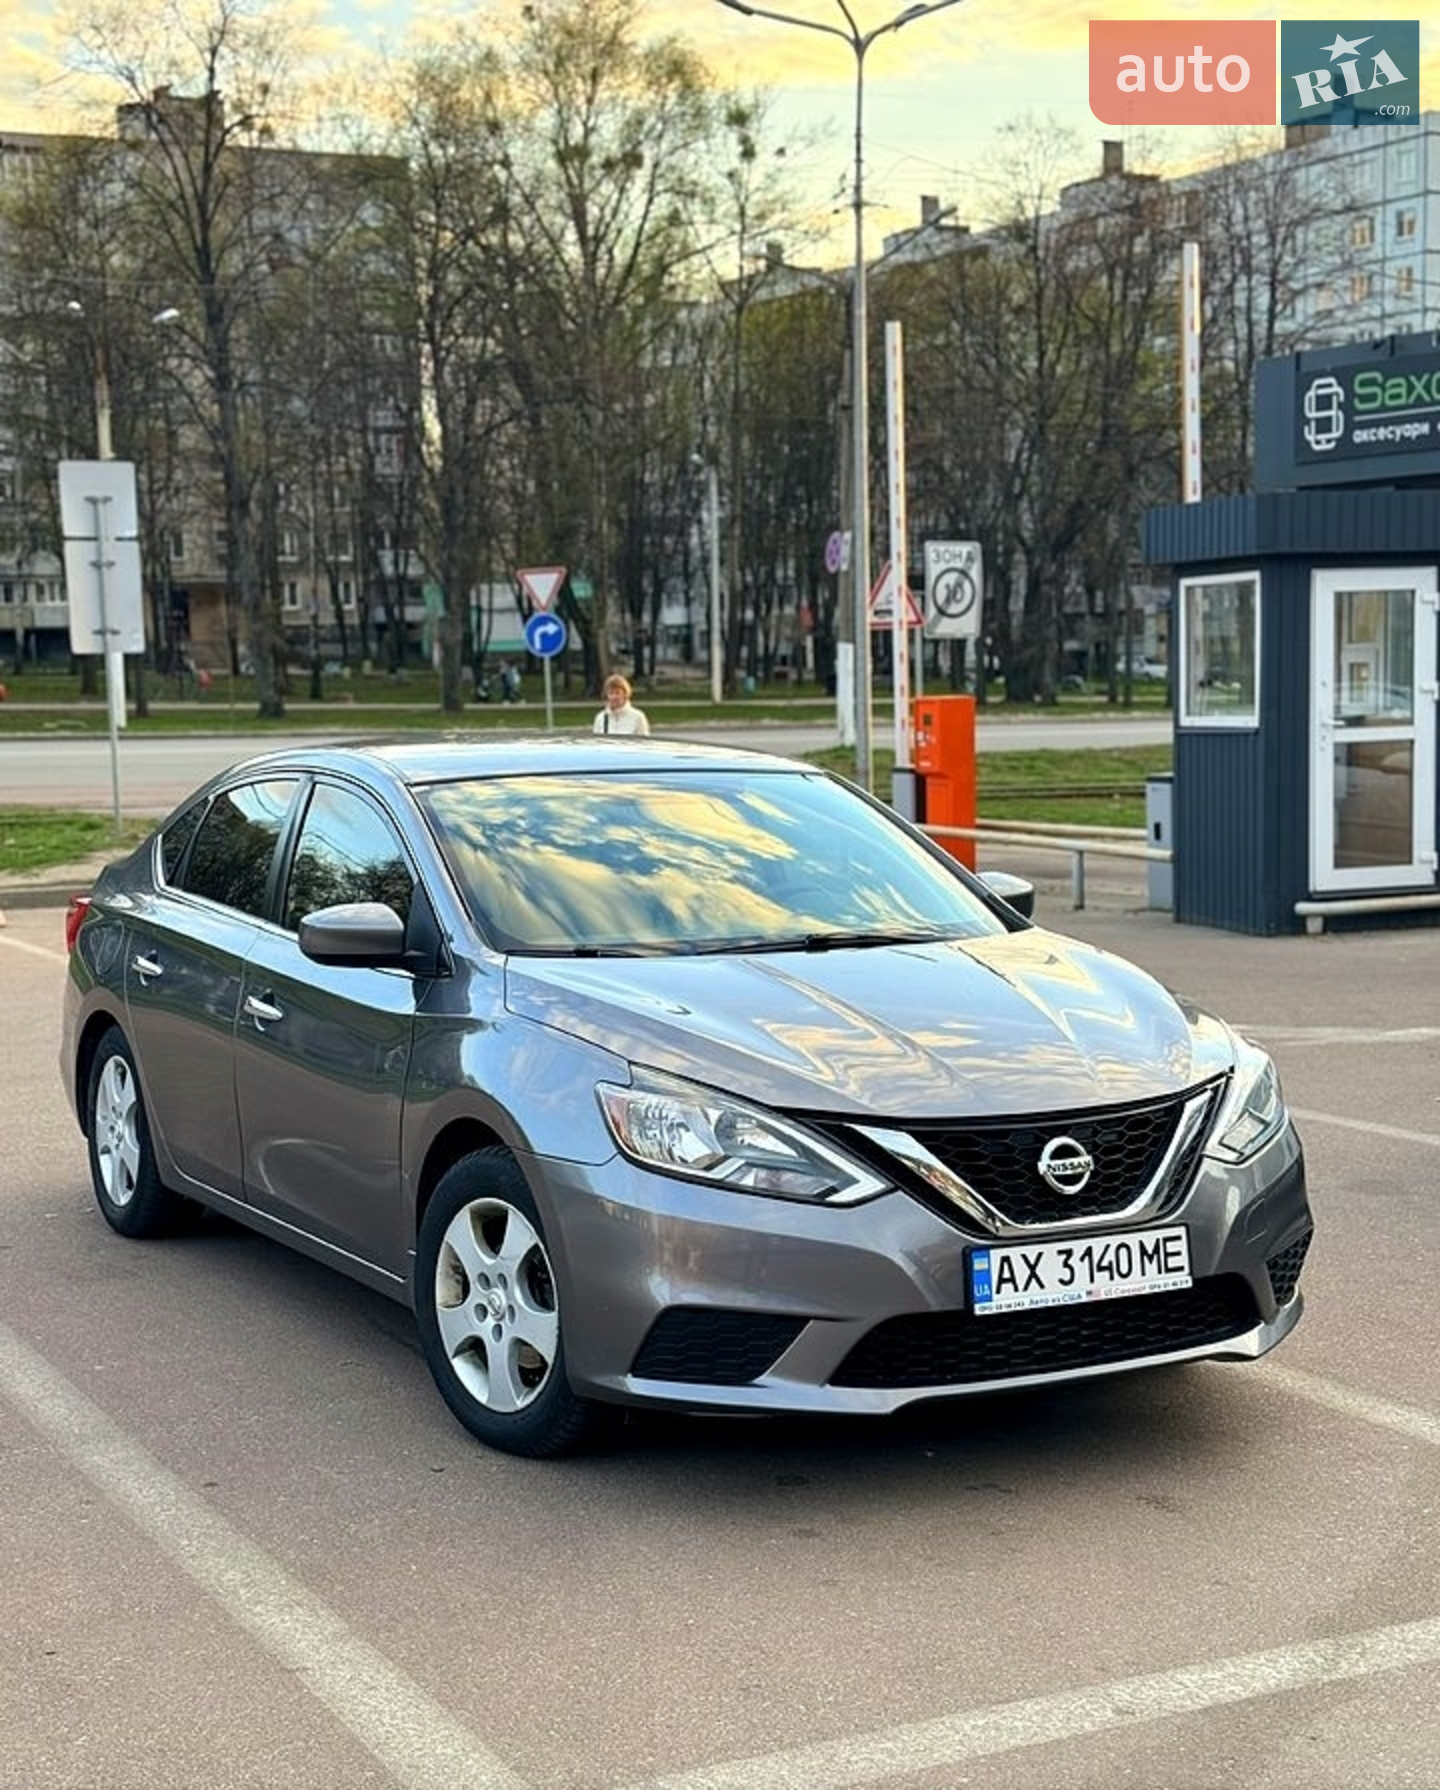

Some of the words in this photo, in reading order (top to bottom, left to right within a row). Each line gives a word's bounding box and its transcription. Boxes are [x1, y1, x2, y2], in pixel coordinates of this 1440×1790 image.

[1352, 422, 1430, 444] аксесуари
[1046, 1160, 1091, 1173] NISSAN
[995, 1251, 1045, 1295] AX
[1056, 1241, 1133, 1287] 3140
[1138, 1234, 1185, 1277] ME
[974, 1283, 991, 1298] UA
